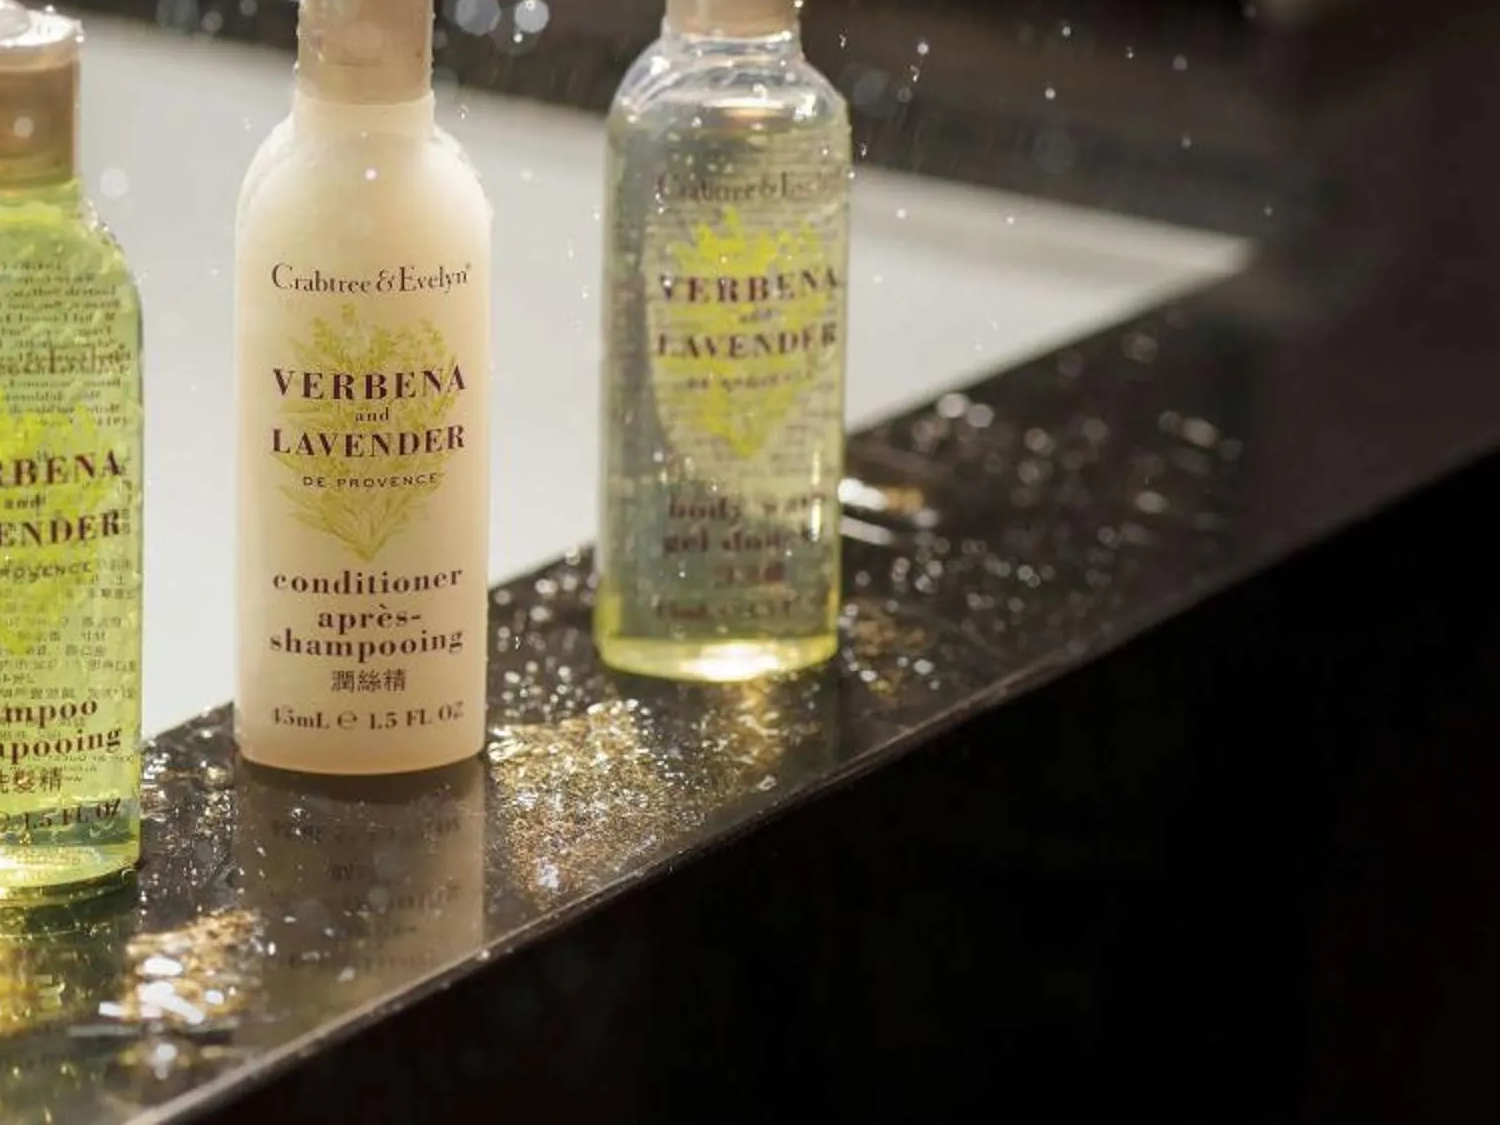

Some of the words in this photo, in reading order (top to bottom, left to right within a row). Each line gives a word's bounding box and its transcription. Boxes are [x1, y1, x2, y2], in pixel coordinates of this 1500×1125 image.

[271, 262, 372, 294] Crabtree
[660, 266, 839, 303] VERBENA
[656, 322, 838, 360] LAVENDER
[272, 364, 468, 401] VERBENA
[355, 407, 390, 423] and
[270, 425, 466, 458] LAVENDER
[303, 475, 326, 488] DE
[337, 472, 439, 489] PROVENCE
[3, 493, 42, 510] and
[272, 568, 464, 595] conditioner
[317, 603, 422, 635] après-
[269, 627, 465, 663] shampooing
[330, 669, 407, 693] 潤絲精
[368, 712, 399, 730] 1.5
[405, 707, 433, 728] FL
